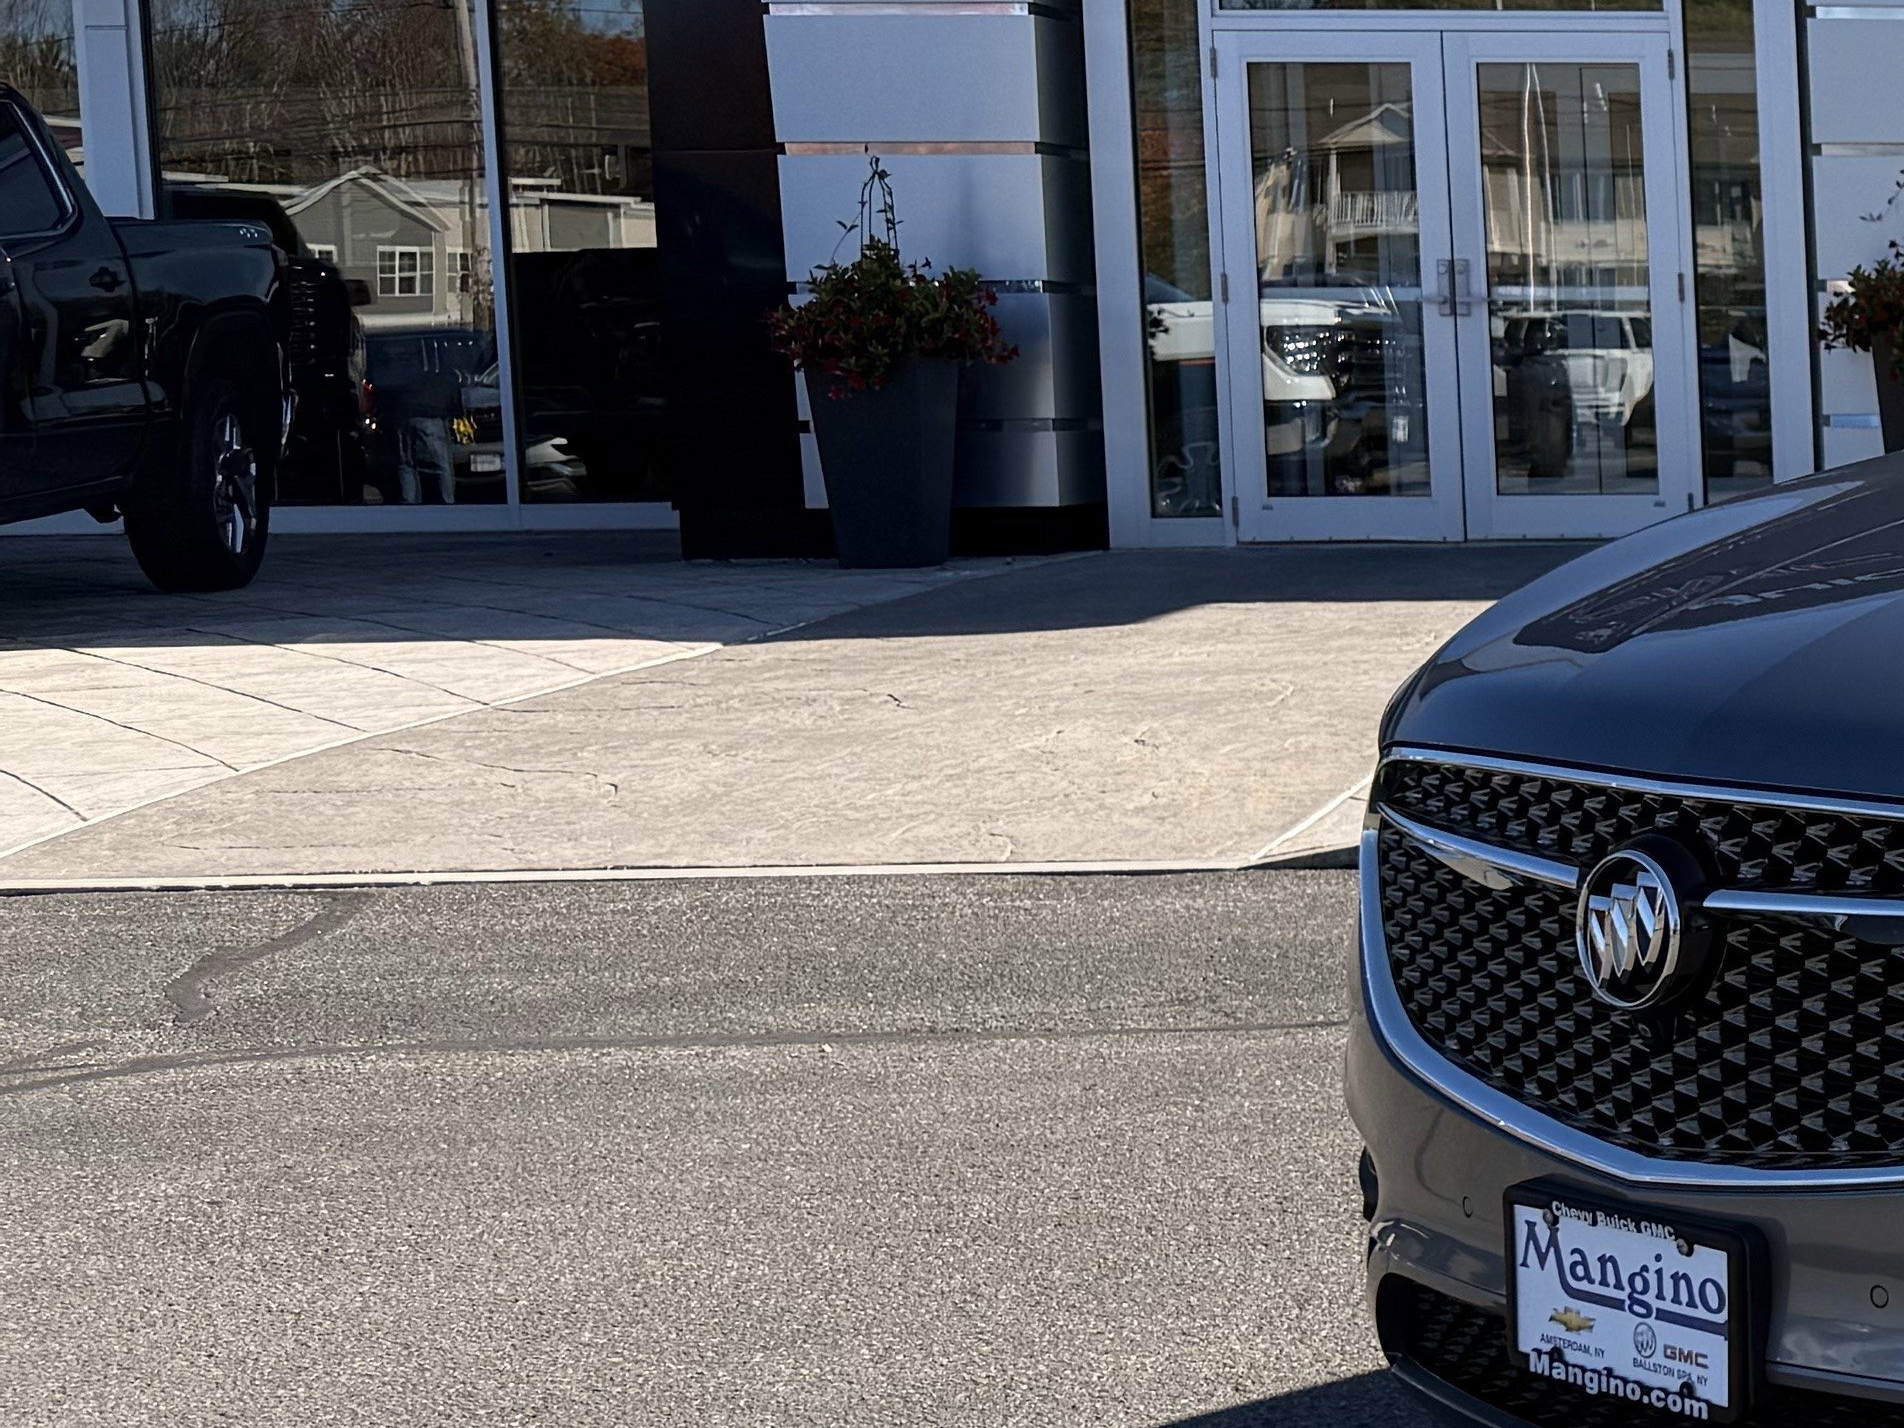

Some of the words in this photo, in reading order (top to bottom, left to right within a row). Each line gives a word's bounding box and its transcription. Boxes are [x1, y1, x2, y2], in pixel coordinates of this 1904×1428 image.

[1552, 1200, 1594, 1228] Chevy
[1596, 1210, 1638, 1234] Buick
[1640, 1220, 1677, 1241] GMC
[1519, 1219, 1728, 1340] Mangino
[1663, 1343, 1709, 1370] GMC
[1529, 1349, 1709, 1421] Mangino.com
